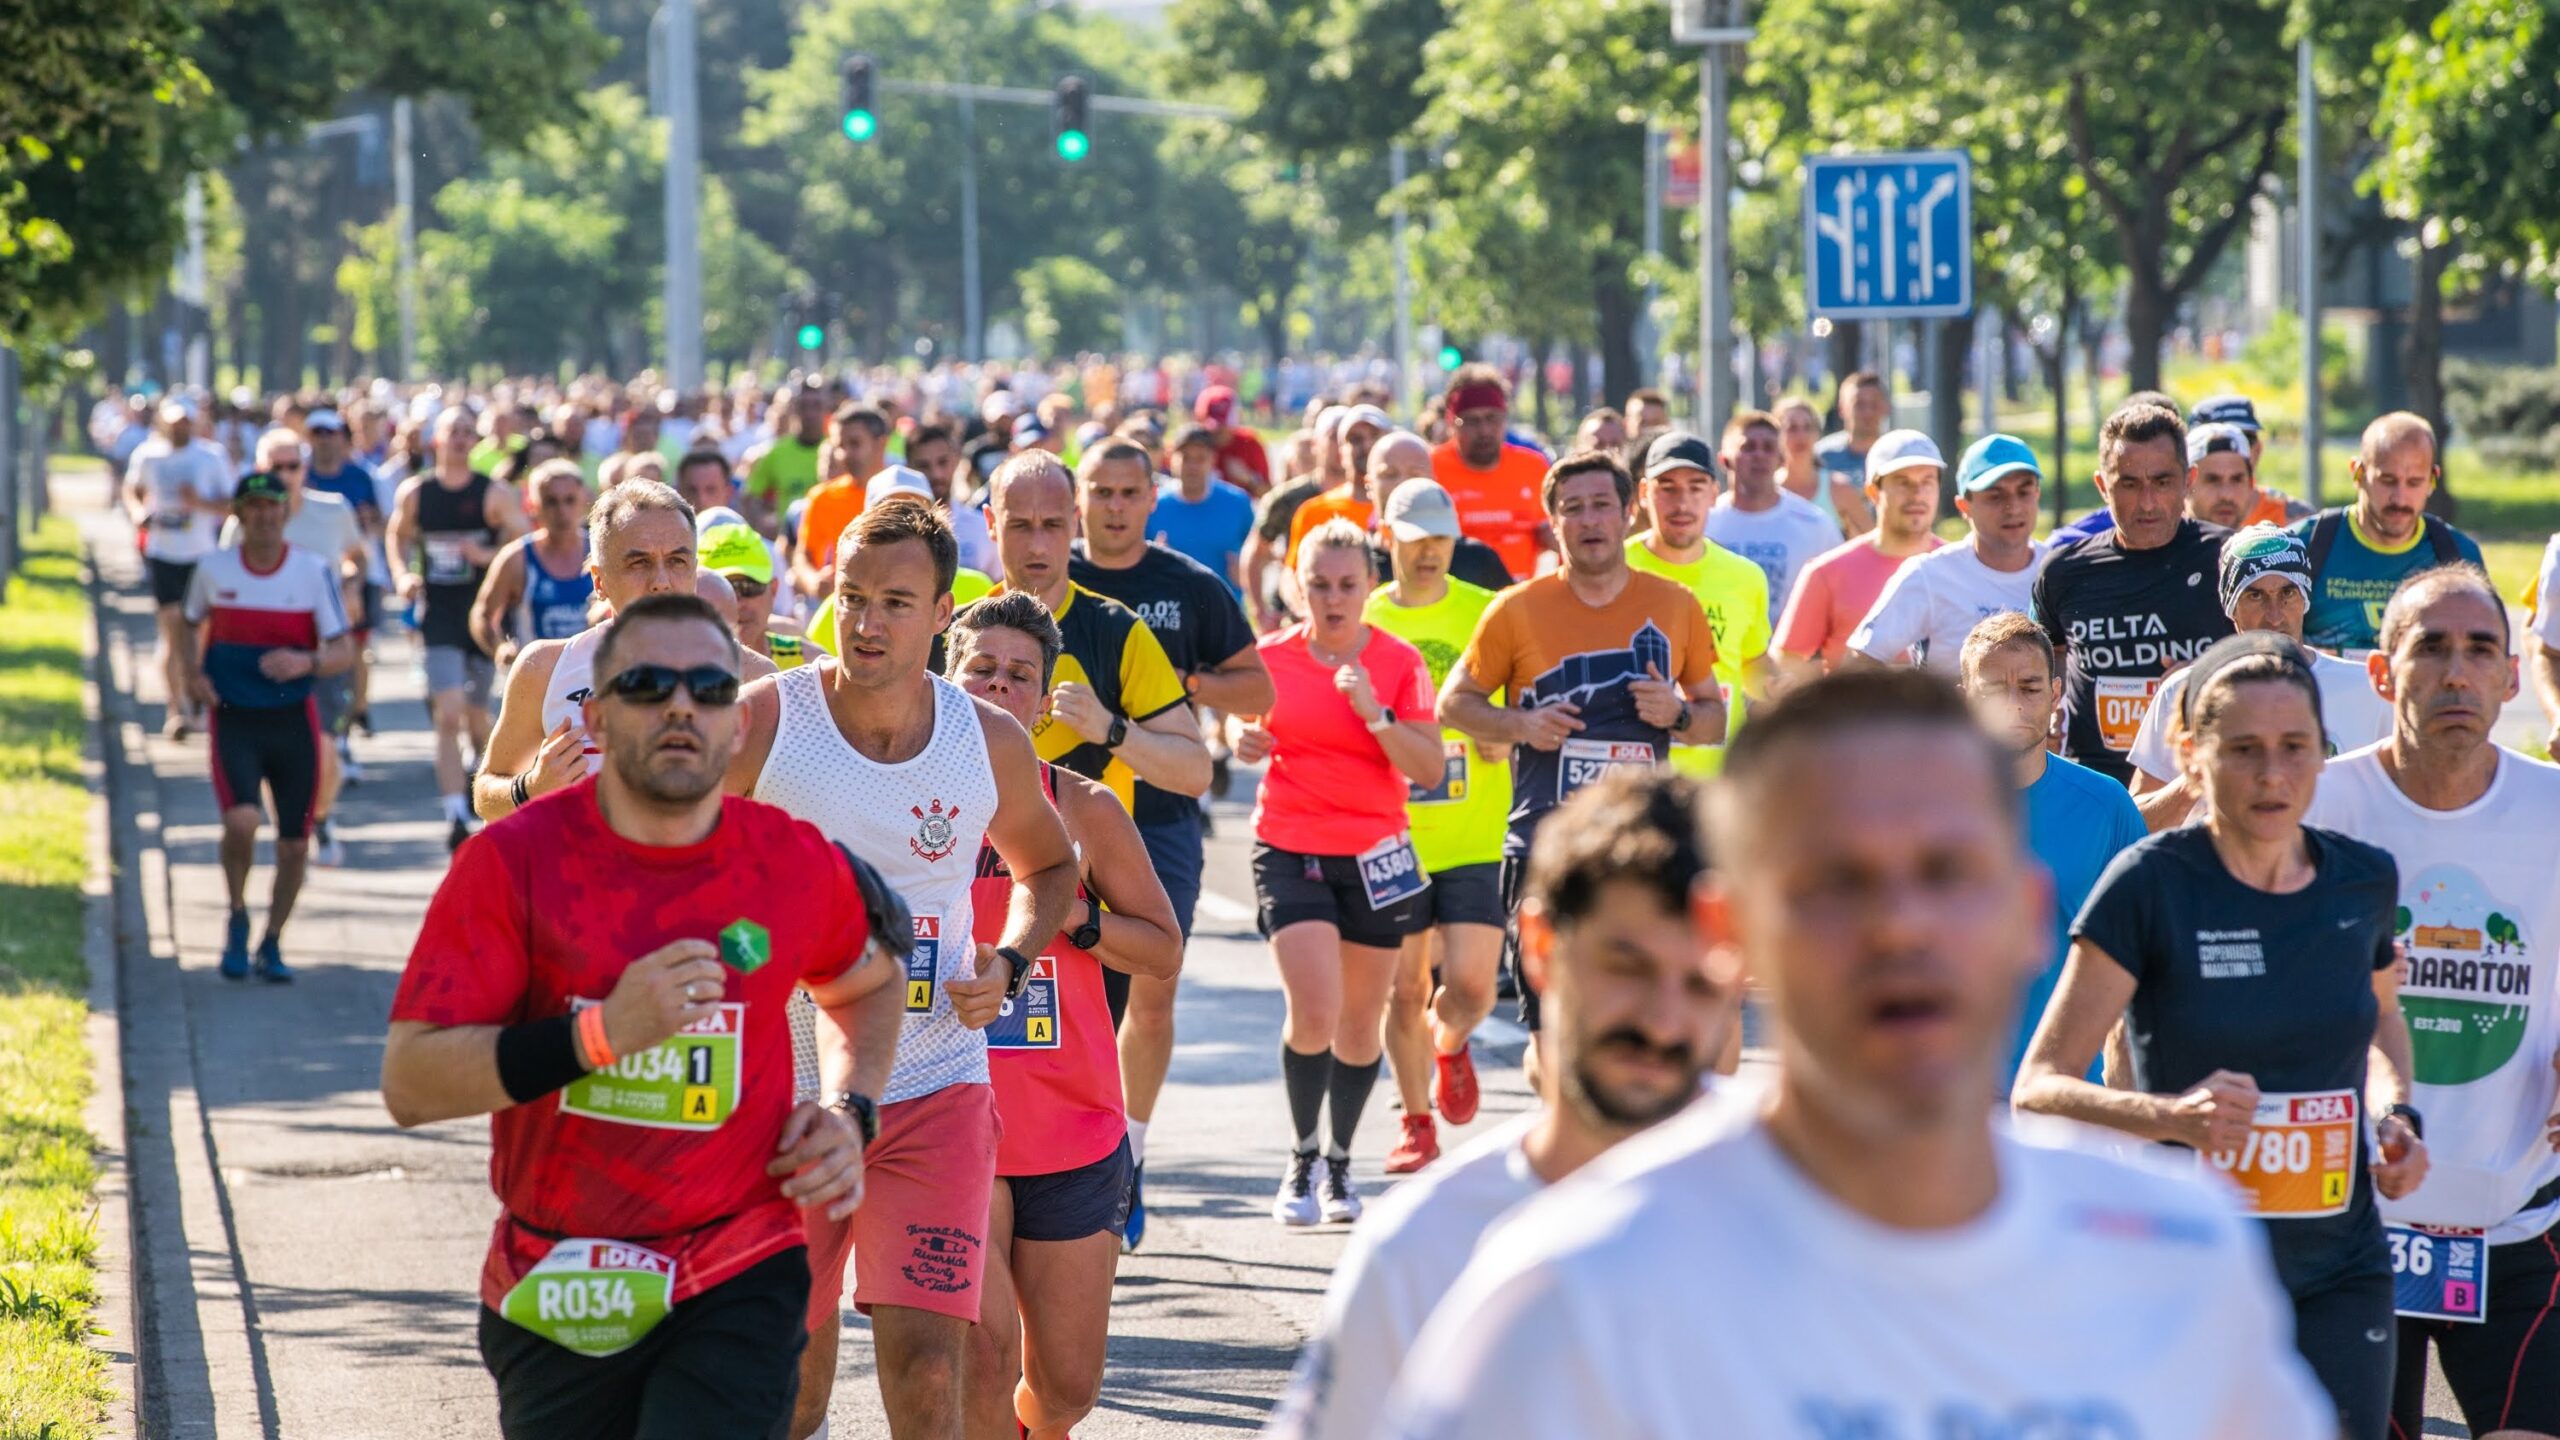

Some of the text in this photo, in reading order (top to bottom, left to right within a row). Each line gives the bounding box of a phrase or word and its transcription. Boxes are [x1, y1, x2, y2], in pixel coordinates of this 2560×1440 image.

[2261, 550, 2301, 568] SOMBOR
[2071, 613, 2168, 642] DELTA
[2079, 637, 2213, 669] HOLDING
[2107, 699, 2148, 726] 014
[1568, 760, 1622, 785] 527
[1367, 848, 1414, 883] 4380
[914, 985, 924, 1003] A
[1035, 1021, 1046, 1038] A
[596, 1045, 684, 1083] 034
[691, 1047, 708, 1084] 1
[693, 1093, 707, 1115] A
[2387, 1233, 2434, 1276] 36
[537, 1278, 636, 1321] R034
[2454, 1287, 2467, 1306] B
